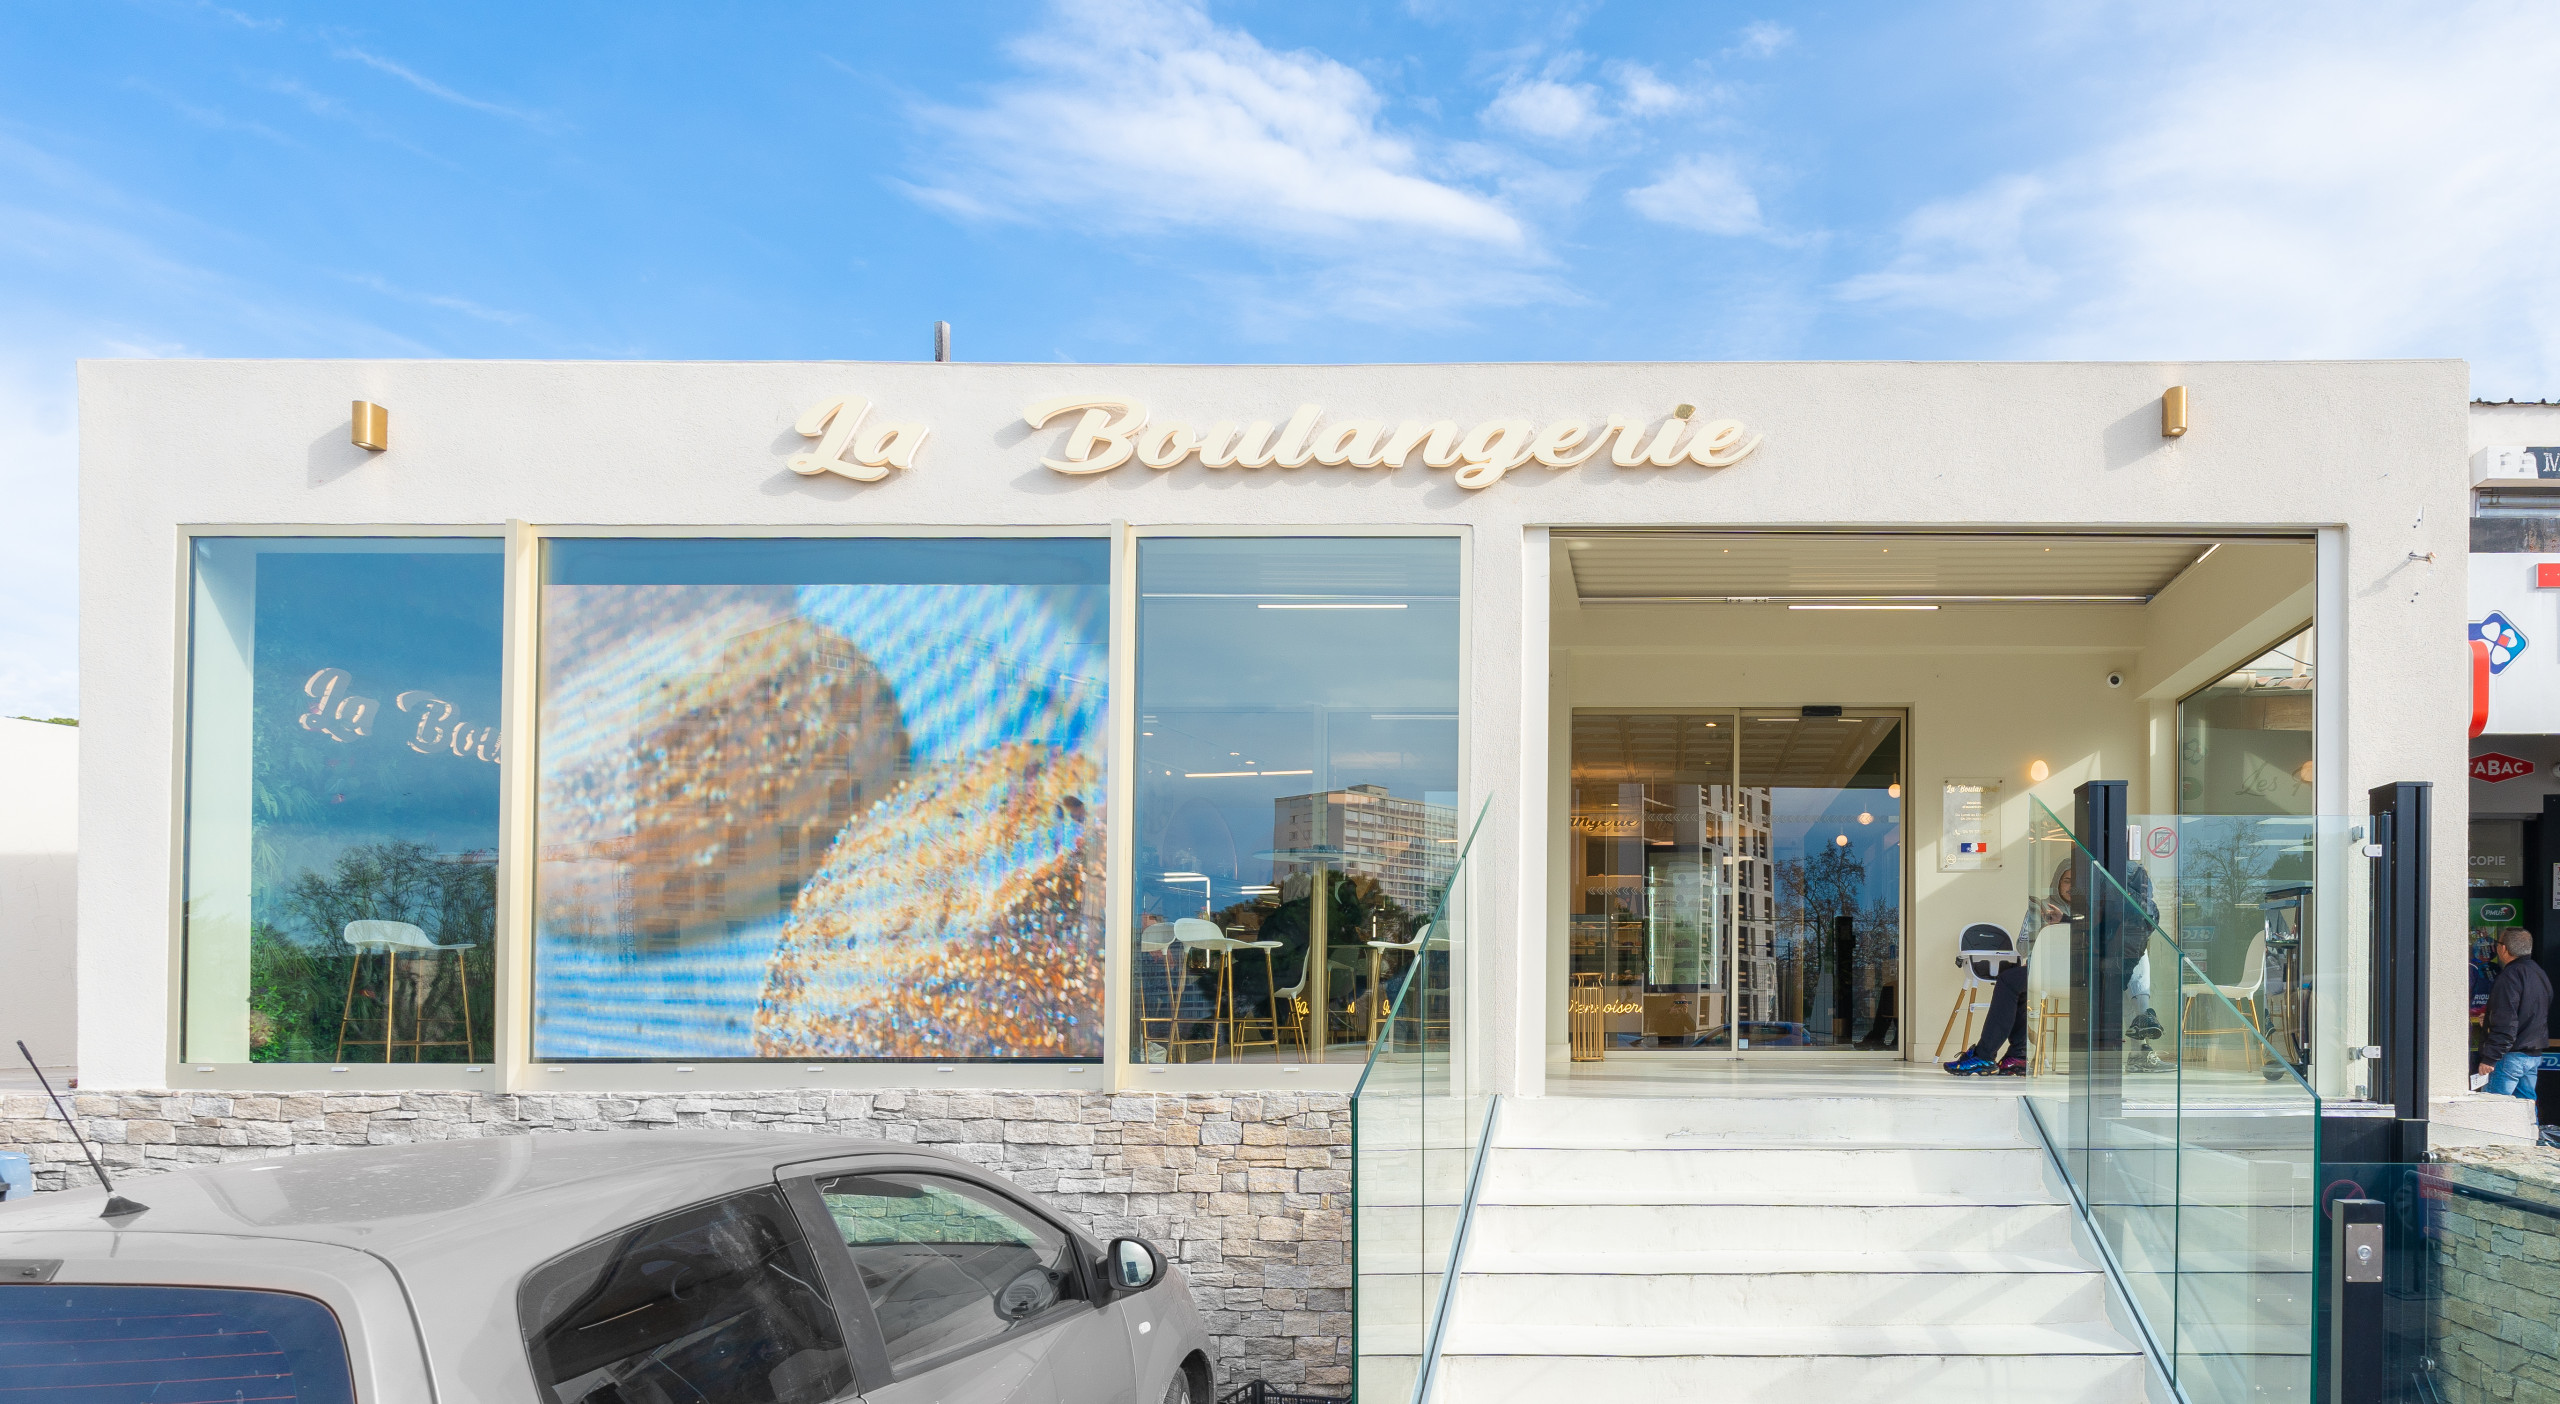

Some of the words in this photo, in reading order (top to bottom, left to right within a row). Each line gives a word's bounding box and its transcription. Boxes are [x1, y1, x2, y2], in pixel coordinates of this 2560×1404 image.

[788, 395, 930, 482] La
[1022, 397, 1764, 490] Boulangerie
[299, 667, 380, 744] La
[2469, 855, 2506, 866] COPIE
